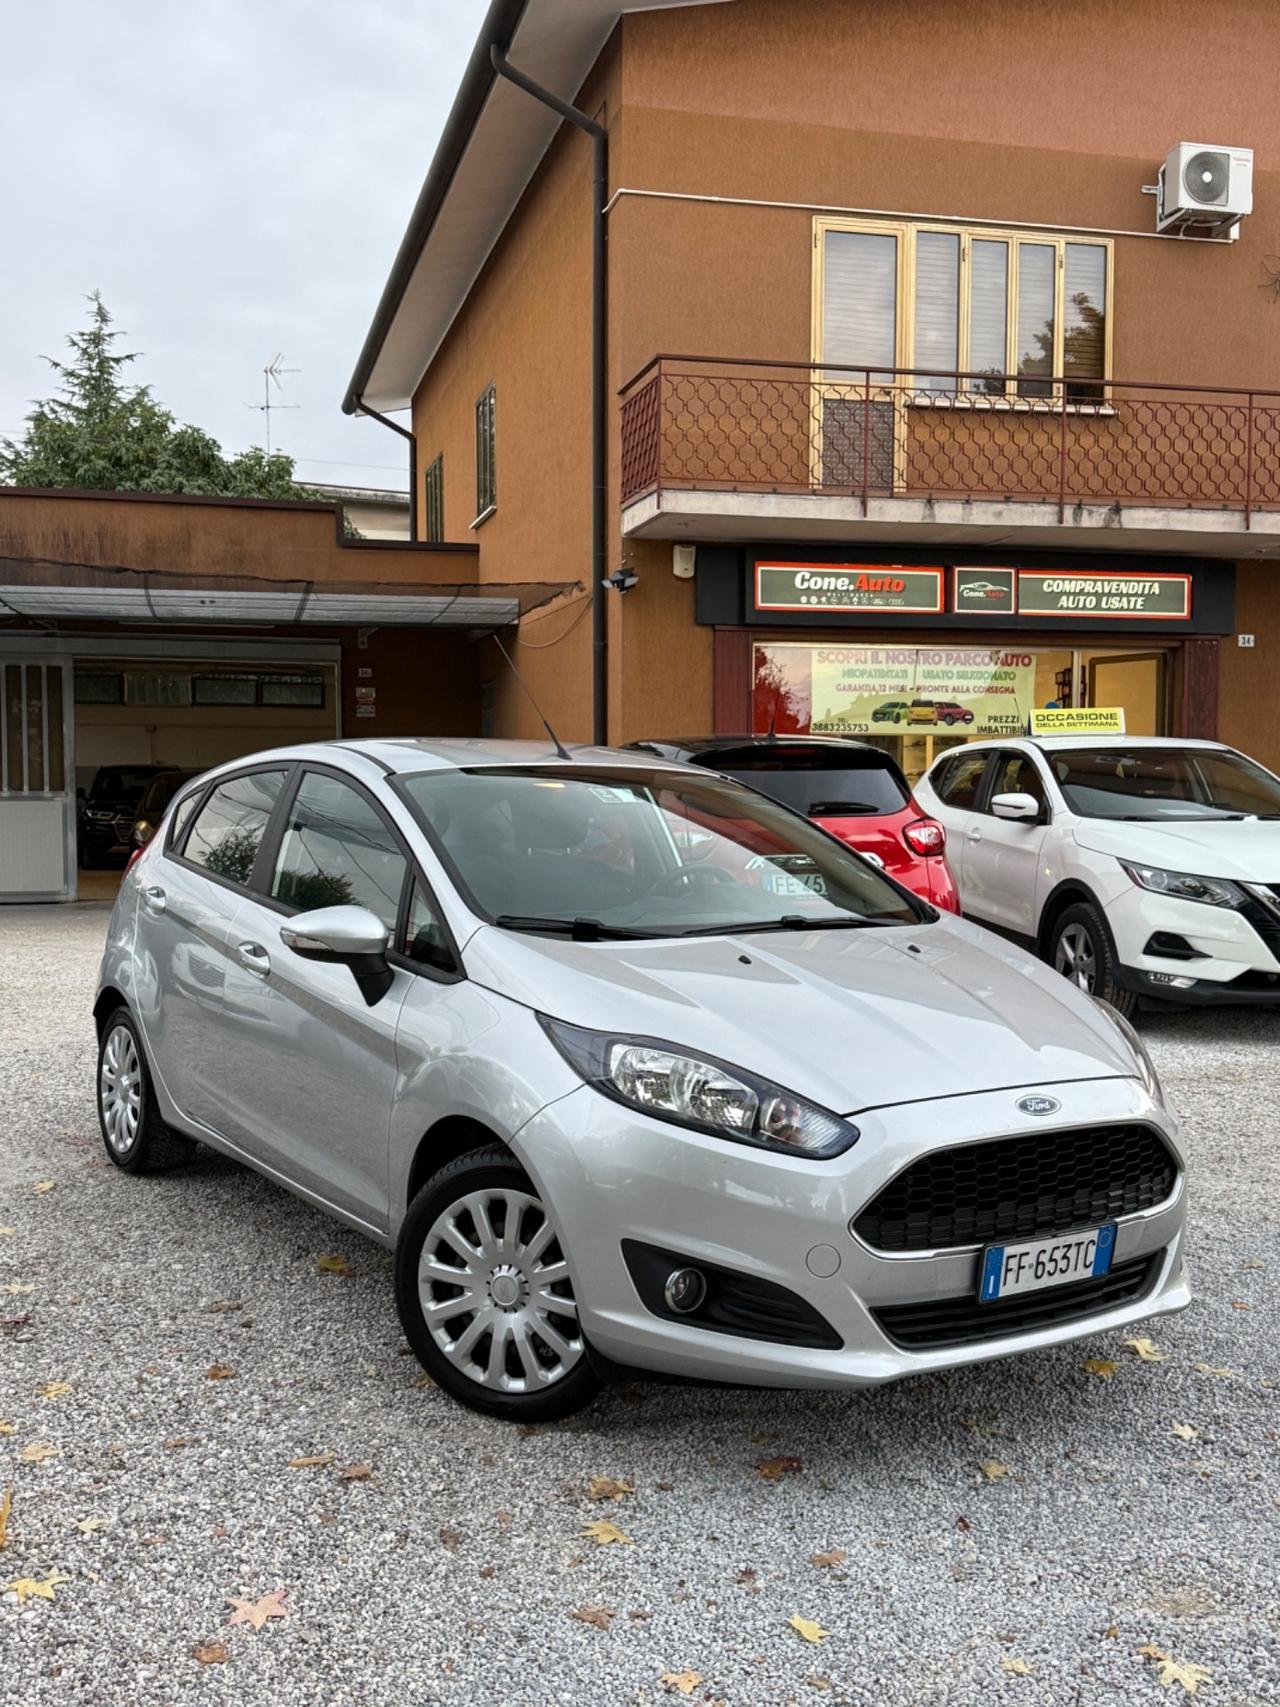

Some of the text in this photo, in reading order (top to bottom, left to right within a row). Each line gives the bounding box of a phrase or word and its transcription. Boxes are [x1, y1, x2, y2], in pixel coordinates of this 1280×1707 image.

[794, 571, 905, 593] Cone.Auto
[1043, 579, 1160, 595] COMPRAVENDITA
[1057, 596, 1145, 610] AUTO USATE
[817, 651, 868, 665] SCOPRI
[871, 651, 882, 665] IL
[885, 651, 943, 666] NOSTRO
[945, 653, 991, 667] PARCO
[923, 670, 955, 680] USATO
[836, 684, 876, 692] GARANZIA
[916, 686, 949, 694] PRONTE
[951, 686, 971, 694] ALLA
[972, 686, 1015, 694] CONSEGNA
[988, 715, 1019, 723] PREZZI
[1036, 713, 1118, 722] OCCASIONE
[812, 723, 869, 732] 3883235753
[1026, 1099, 1051, 1111] Ford
